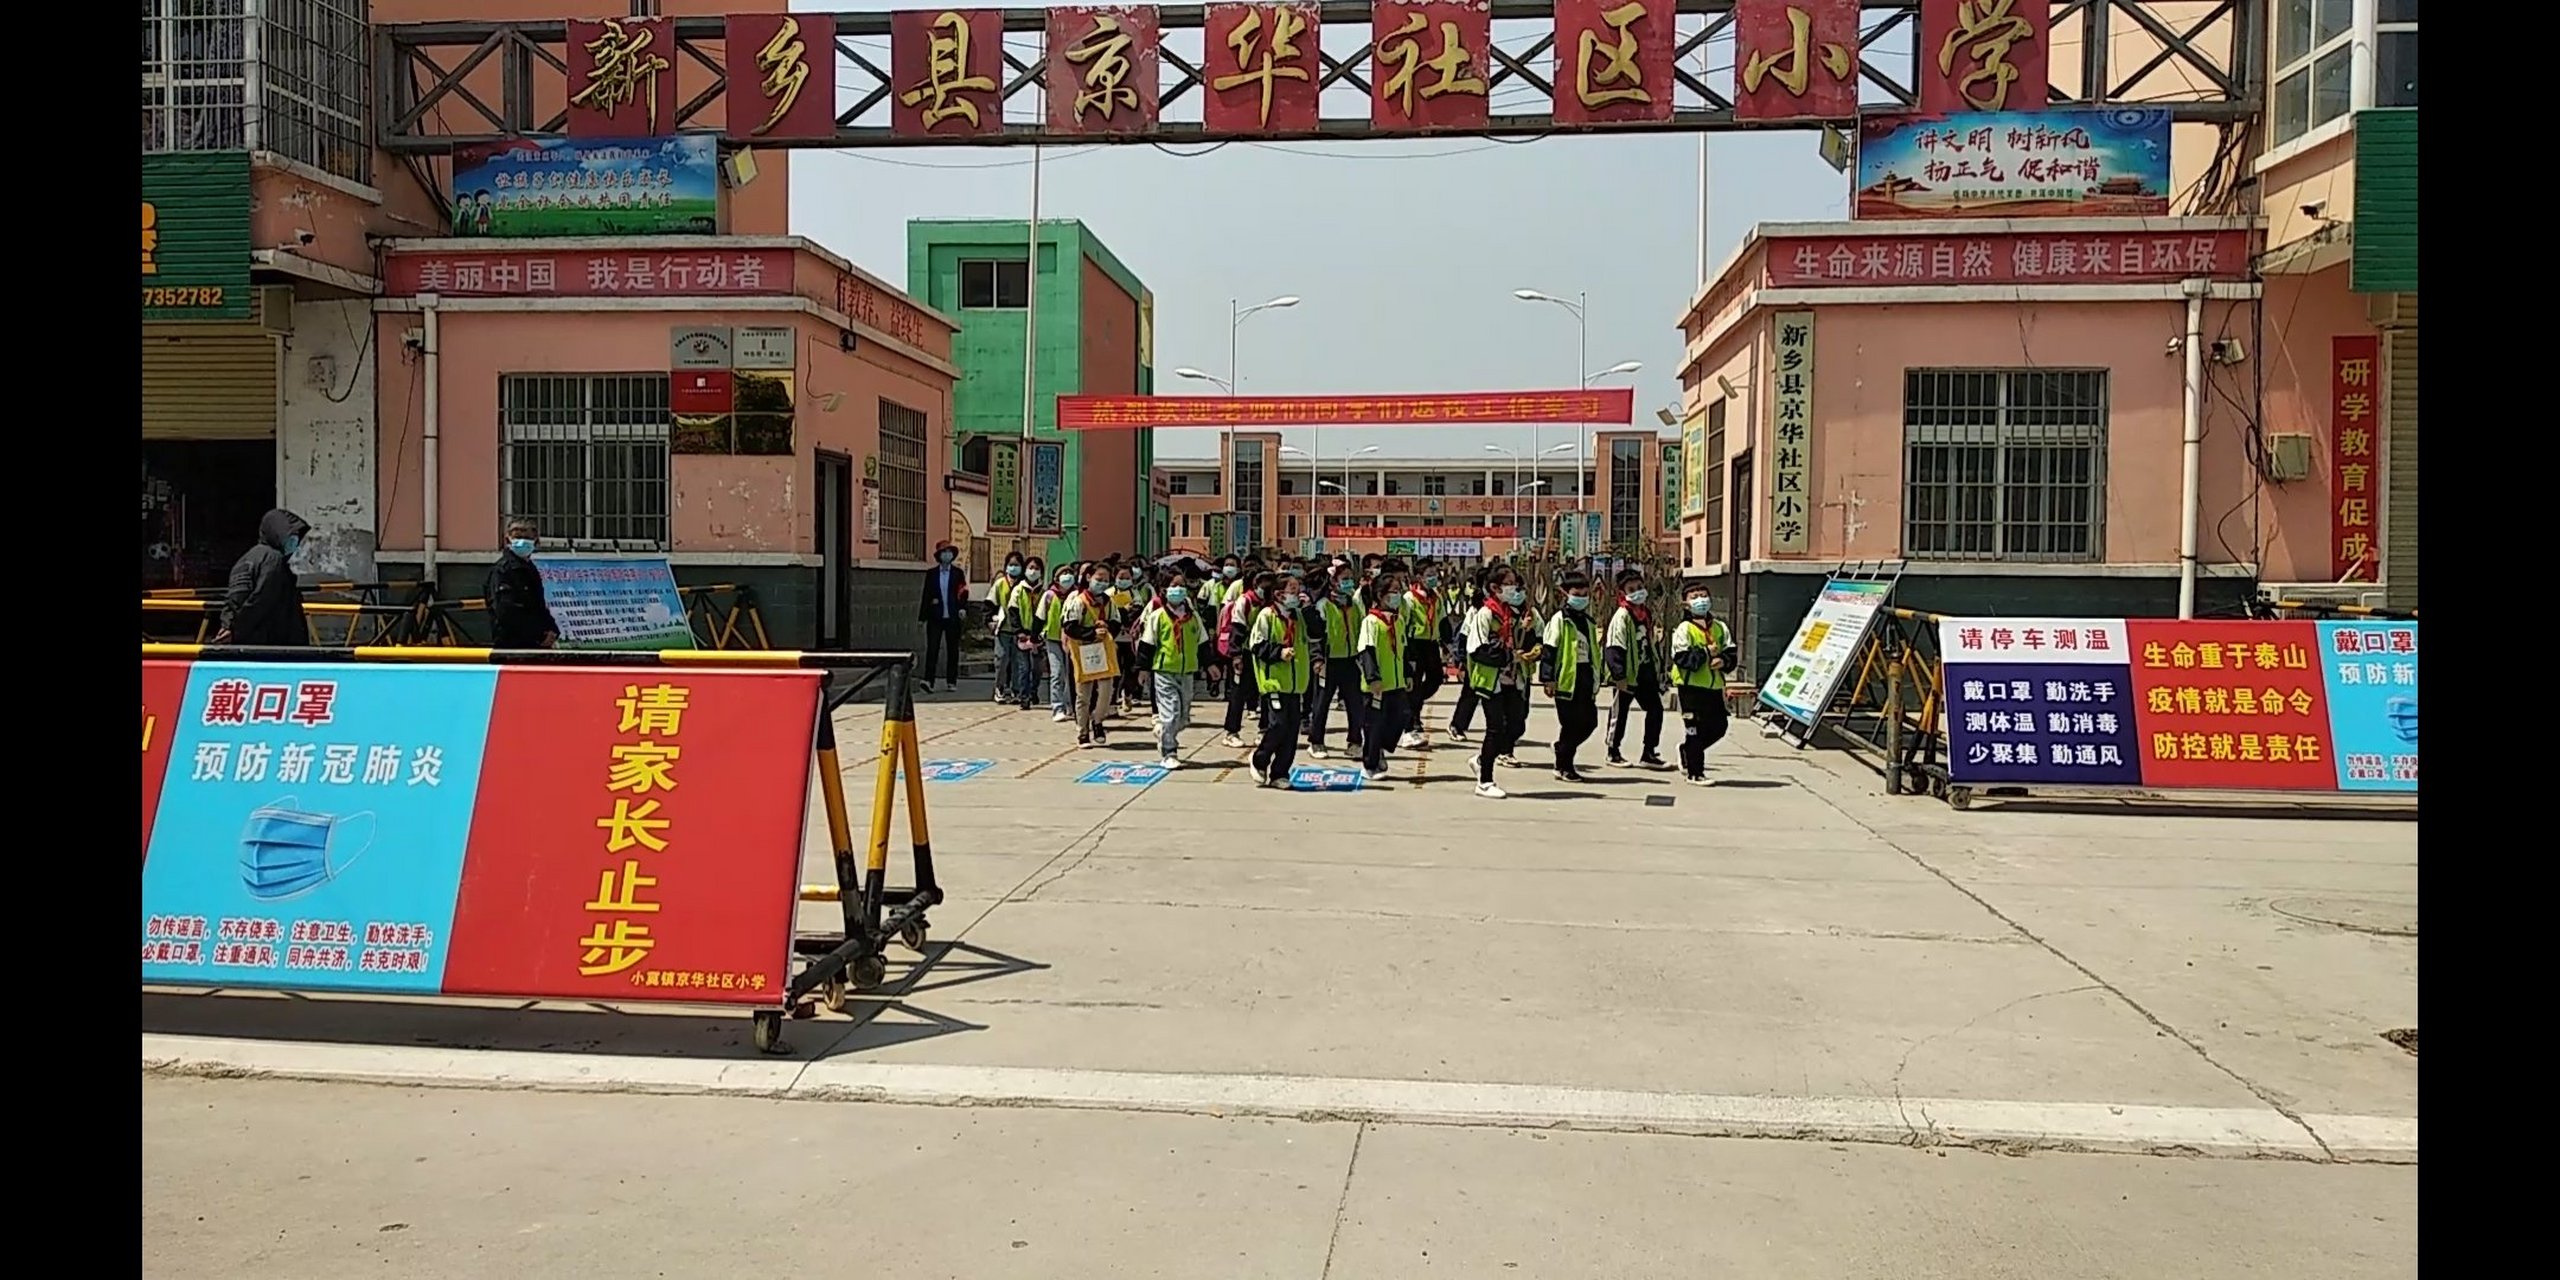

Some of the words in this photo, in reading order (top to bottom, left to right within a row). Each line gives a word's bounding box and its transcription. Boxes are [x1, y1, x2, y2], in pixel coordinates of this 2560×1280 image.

[571, 0, 2035, 136] 新乡县京华社区小学
[1914, 126, 1993, 154] 讲文明
[2006, 124, 2091, 152] 树新风
[1923, 157, 2005, 183] 扬正气
[2017, 155, 2101, 182] 促和谐
[1793, 240, 1994, 278] 生命来源自然
[2012, 236, 2217, 276] 健康来自环保
[418, 259, 557, 292] 美丽中国
[587, 255, 766, 290] 我是行动者
[143, 287, 223, 306] 7352782
[1774, 324, 1808, 542] 新乡县京华社区小学
[1959, 628, 2111, 651] 请停车测温
[2335, 630, 2414, 652] 戴口罩
[2143, 641, 2308, 670] 生命重于泰山
[2338, 662, 2416, 685] 预防新
[206, 681, 335, 725] 戴口罩
[1962, 680, 2033, 702] 戴口罩
[2045, 681, 2116, 702] 勤洗手
[2147, 687, 2314, 717] 疫情就是命令
[1965, 711, 2035, 733] 测体温
[2048, 711, 2119, 734] 勤消毒
[1968, 743, 2038, 765] 少聚集
[2051, 743, 2123, 766] 勤通风
[2153, 732, 2321, 763] 防控就是责任
[191, 741, 444, 786] 预防新冠肺炎
[578, 683, 690, 977] 请家长止步
